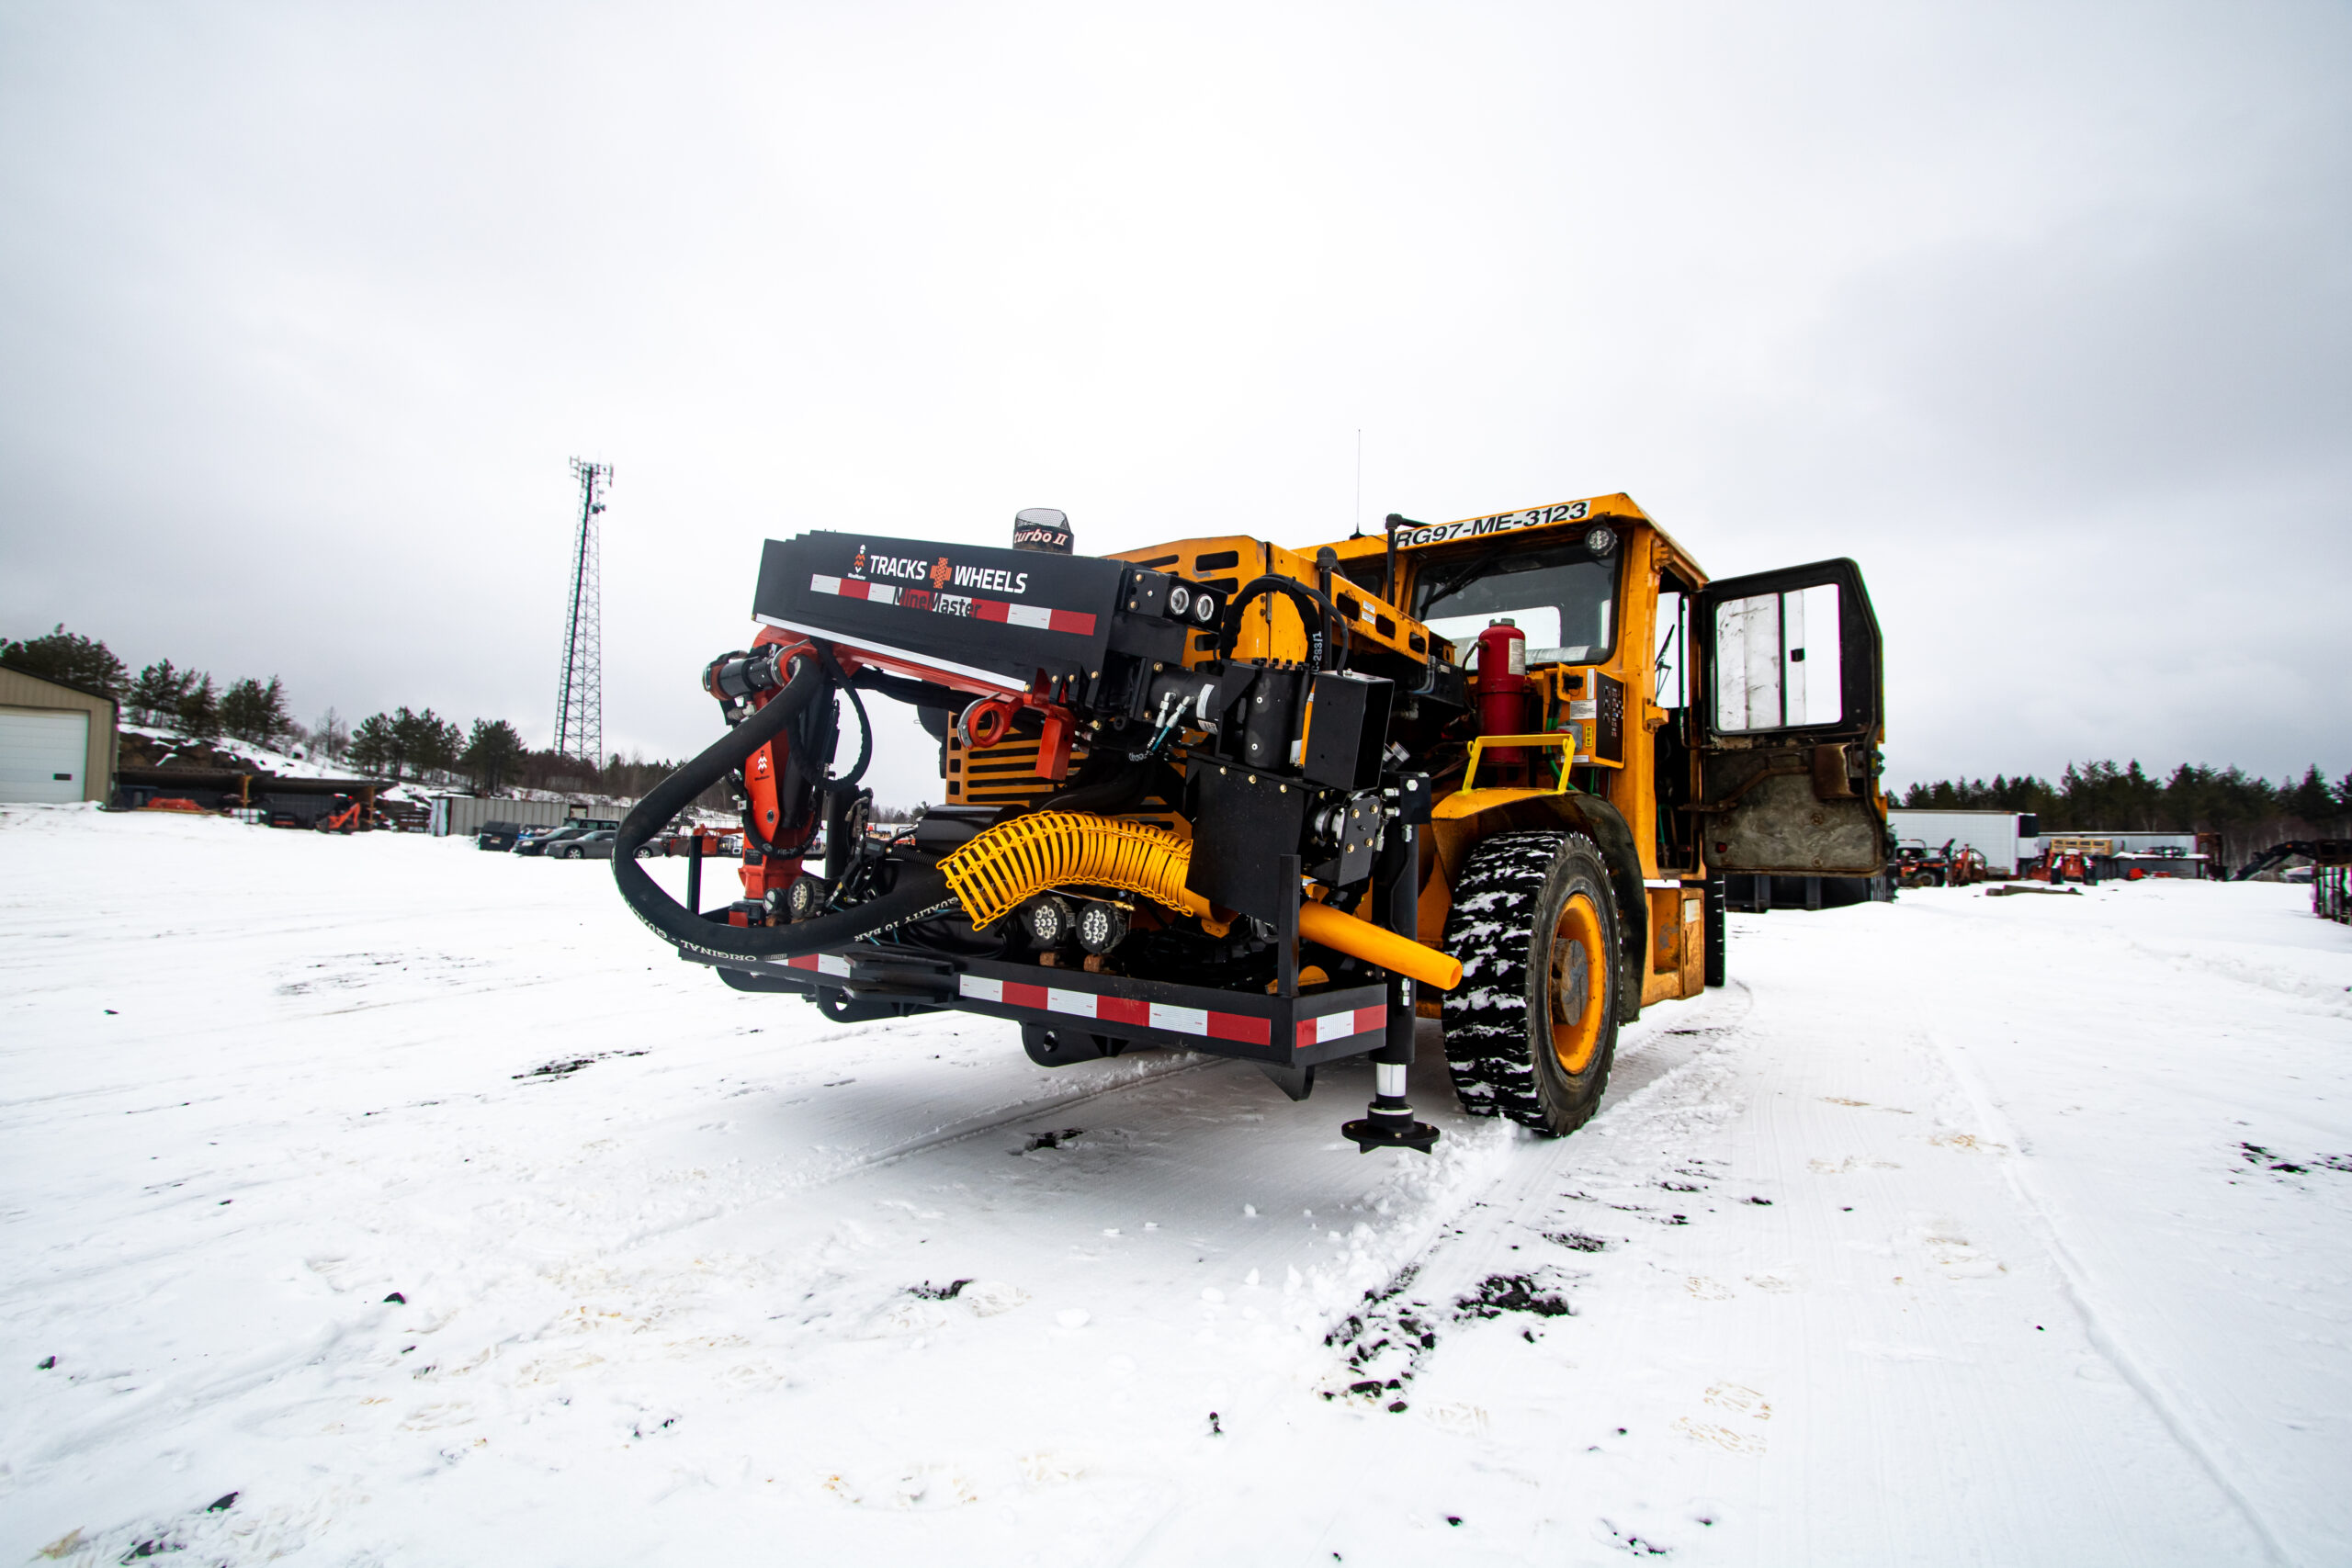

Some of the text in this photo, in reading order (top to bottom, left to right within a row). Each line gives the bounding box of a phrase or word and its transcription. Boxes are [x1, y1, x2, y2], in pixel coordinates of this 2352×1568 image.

[1013, 528, 1053, 544] turbo
[1395, 502, 1588, 548] RG97-ME-3123
[870, 555, 1029, 594] TRACKS WHEELS
[893, 586, 983, 618] MineMaster
[903, 897, 959, 924] QUALITY
[854, 927, 882, 942] BAR
[680, 939, 757, 962] ORIGINAL
